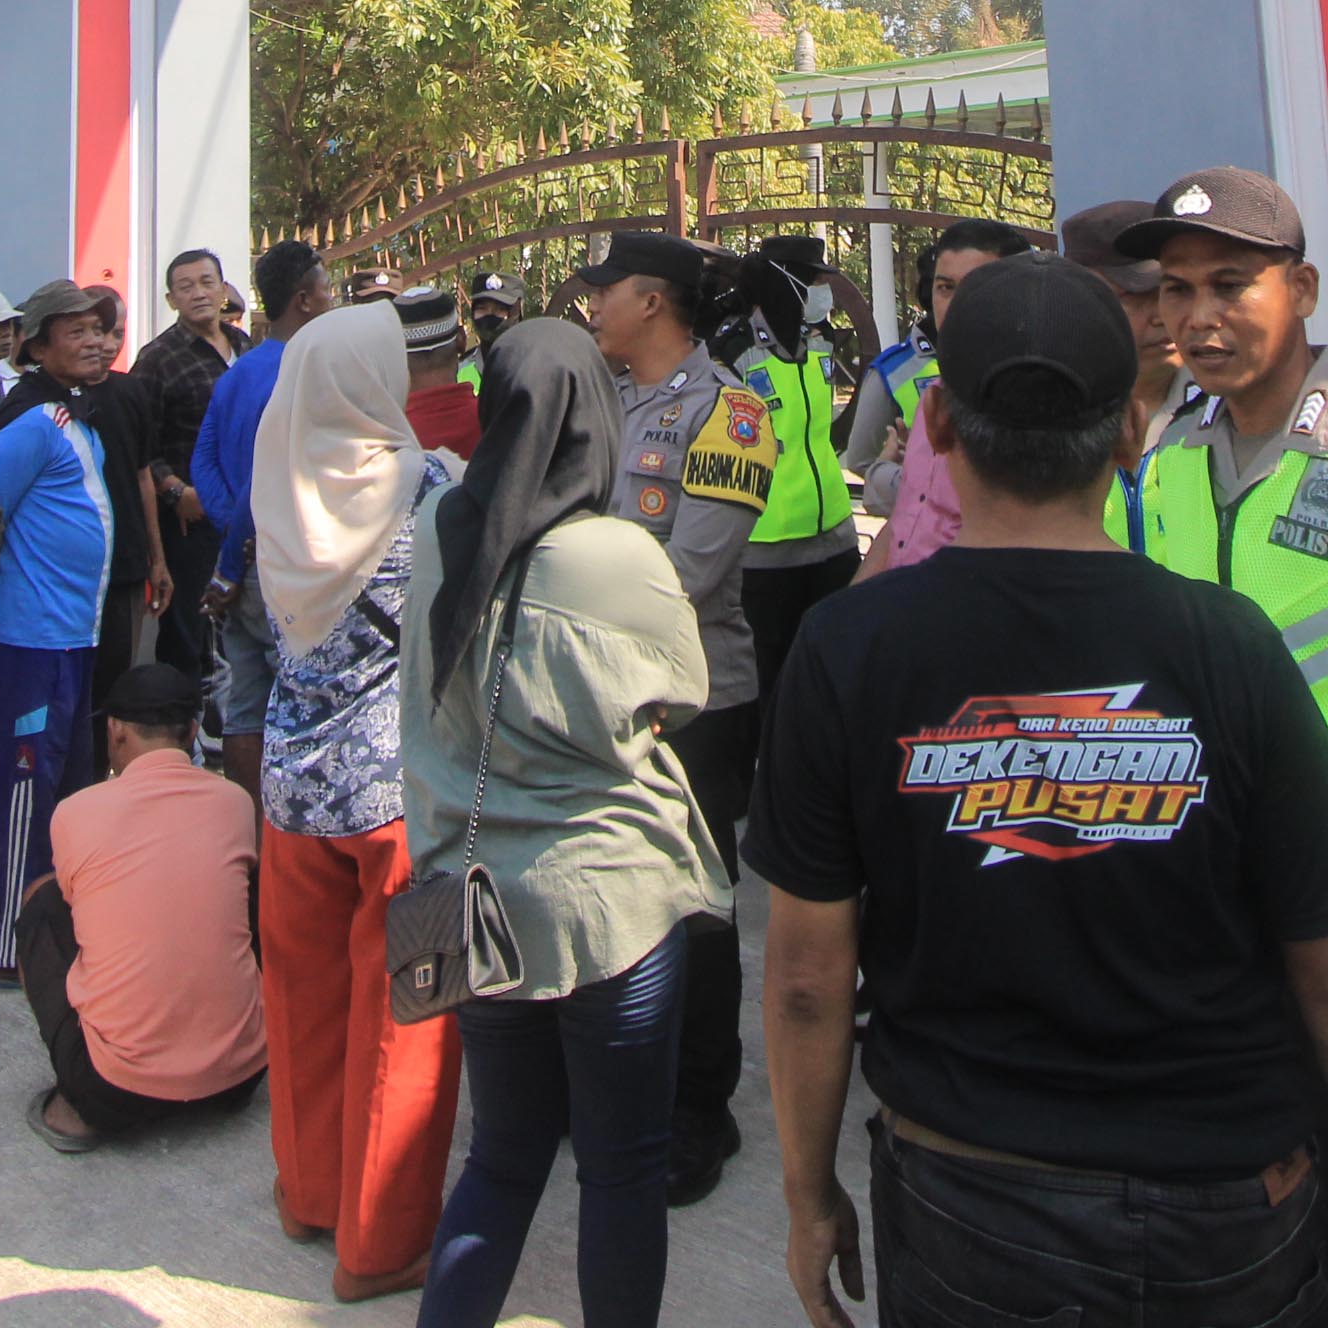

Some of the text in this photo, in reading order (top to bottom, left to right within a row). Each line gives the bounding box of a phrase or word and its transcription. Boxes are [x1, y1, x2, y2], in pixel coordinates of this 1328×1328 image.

[643, 429, 679, 446] POLRI
[1112, 717, 1193, 733] DIDEBAT
[905, 739, 1196, 785] DEKENGAN
[957, 778, 1202, 823] PUSAT
